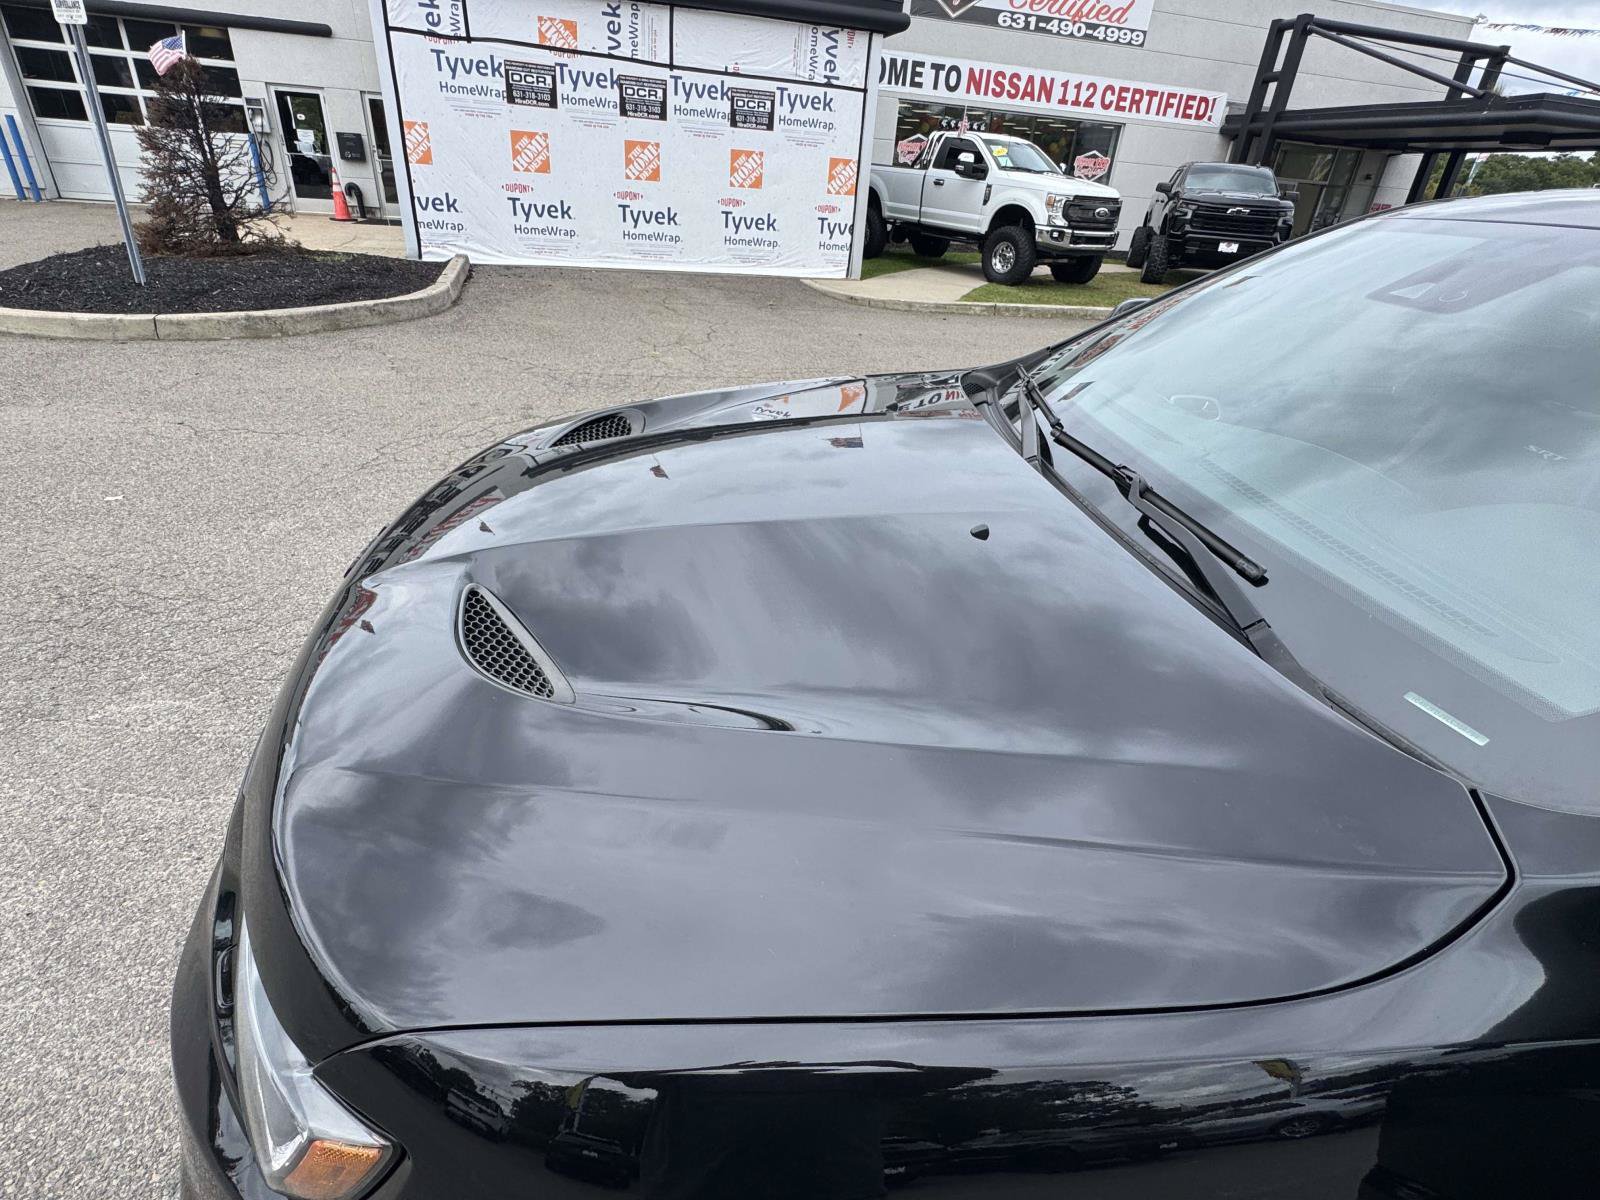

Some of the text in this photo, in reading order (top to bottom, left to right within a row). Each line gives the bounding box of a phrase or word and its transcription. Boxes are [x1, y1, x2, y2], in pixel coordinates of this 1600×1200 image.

[601, 1, 621, 55] vek
[997, 11, 1144, 45] 631-490-4999
[430, 49, 504, 80] Tyvek
[510, 72, 547, 87] DCR
[554, 62, 620, 92] Tyvek
[512, 89, 551, 101] 631-318-3103
[624, 87, 658, 99] DCR
[669, 75, 730, 103] Tyvek
[776, 87, 833, 113] Tyvek
[930, 62, 962, 93] TO
[965, 67, 1055, 104] NISSAN
[1057, 79, 1098, 108] 112
[1100, 84, 1217, 122] CERTIFIED!
[735, 98, 767, 110] DCR
[778, 115, 834, 131] HomeWrap
[513, 132, 550, 173] THE HOME DEPOT
[626, 142, 660, 181] THE HOME DEPOT
[730, 151, 763, 187] HOME
[505, 183, 531, 194] DUPONT
[616, 191, 640, 201] DUPONT
[839, 175, 857, 195] DEPO
[507, 197, 572, 223] Tyvek
[720, 197, 743, 208] DUPONT
[618, 204, 678, 229] Tyvek
[721, 211, 777, 234] Tyvek
[514, 224, 576, 239] HomeWrap
[622, 230, 680, 244] HomeWrap
[724, 236, 778, 249] HomeWrap
